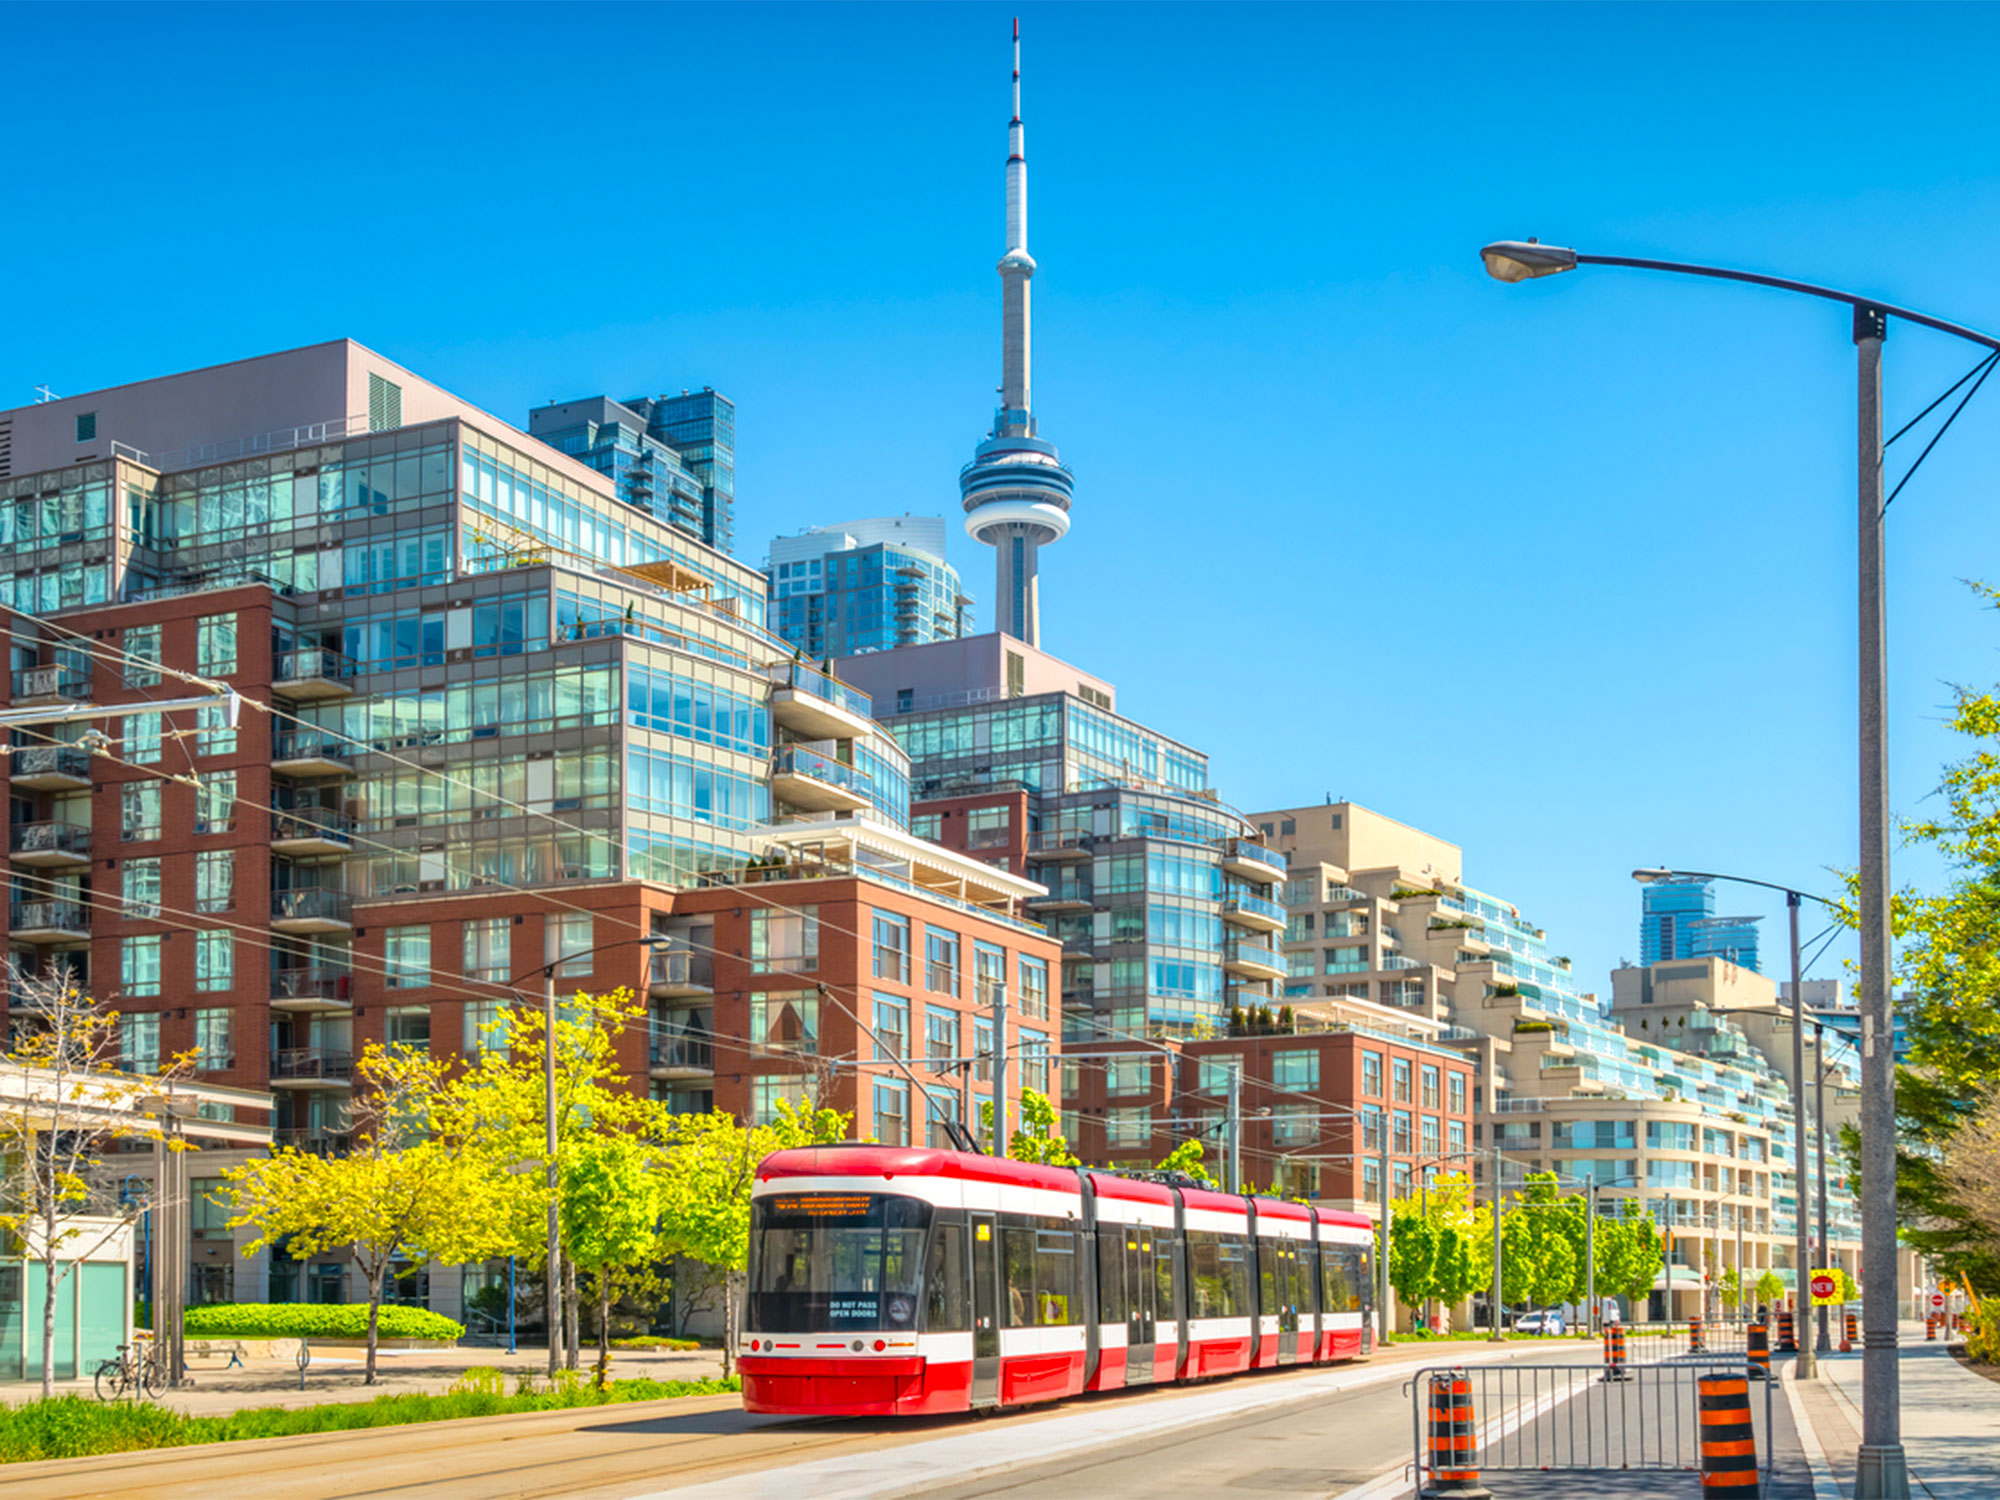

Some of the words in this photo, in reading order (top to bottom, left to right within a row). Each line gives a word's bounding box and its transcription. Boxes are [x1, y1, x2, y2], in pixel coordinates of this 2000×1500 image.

[1811, 1282, 1833, 1293] NEW
[829, 1301, 840, 1309] DO
[842, 1301, 856, 1309] NOT
[858, 1301, 877, 1309] PASS
[829, 1310, 849, 1318] OPEN
[851, 1310, 877, 1318] DOORS
